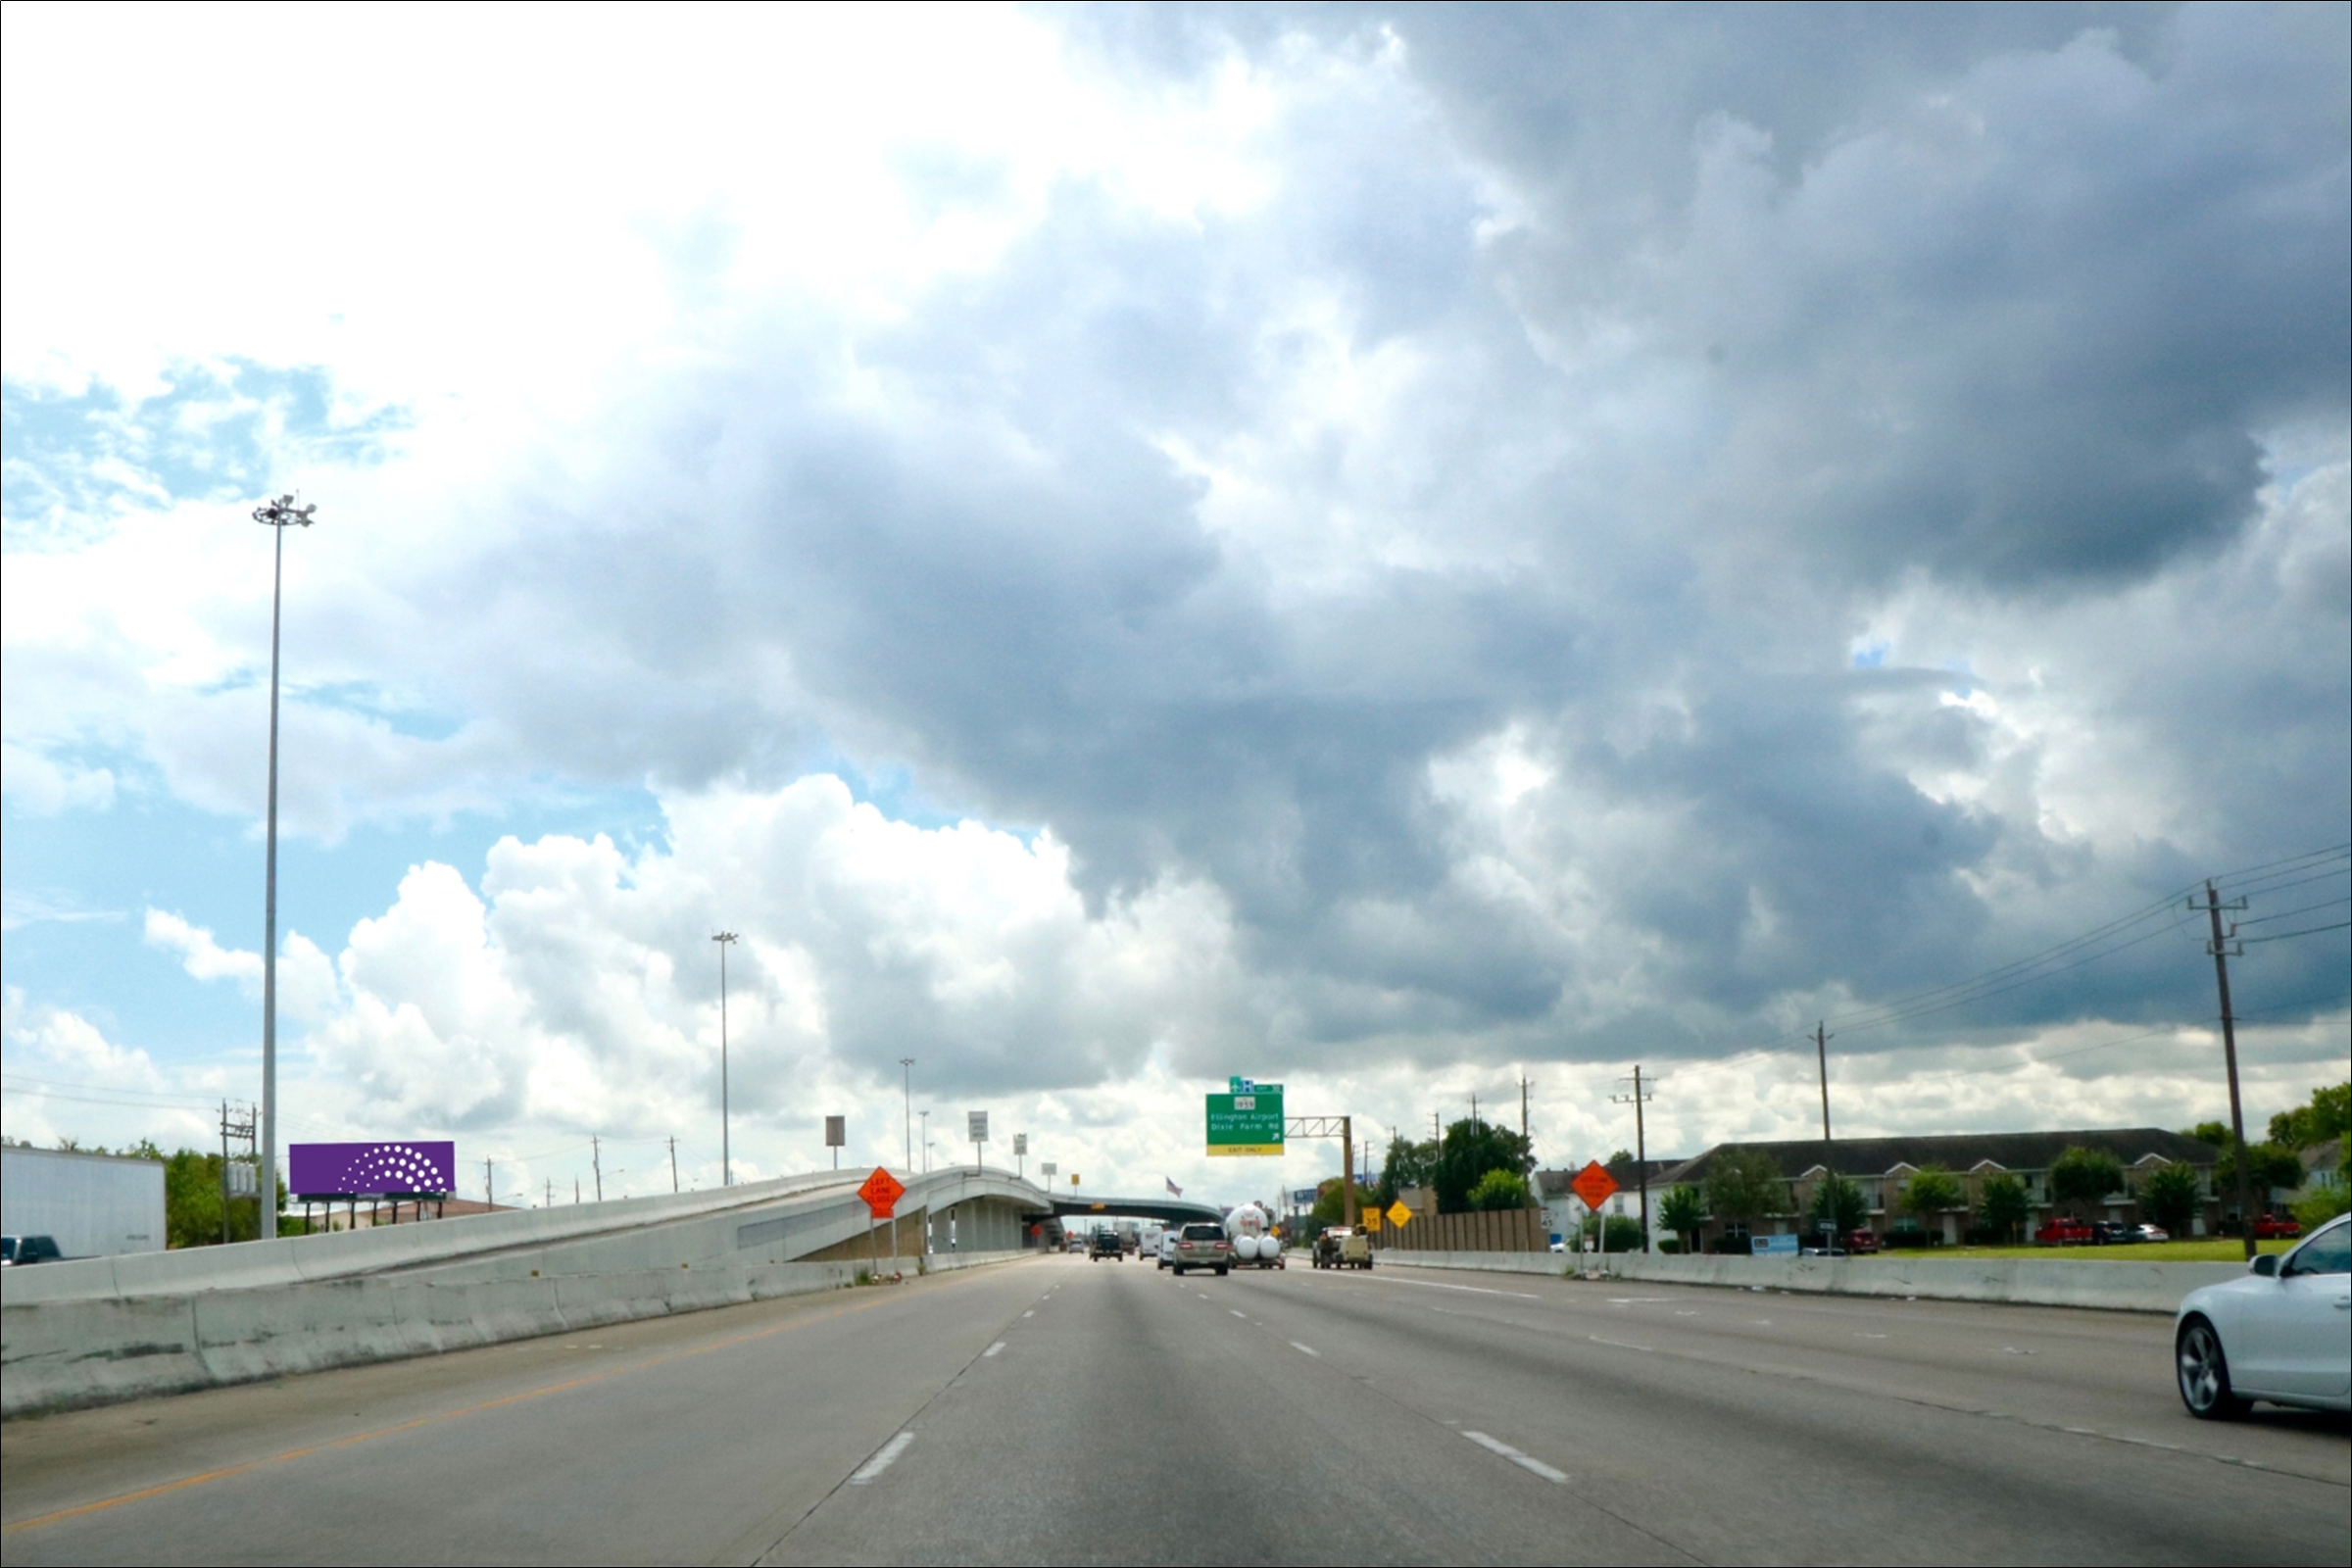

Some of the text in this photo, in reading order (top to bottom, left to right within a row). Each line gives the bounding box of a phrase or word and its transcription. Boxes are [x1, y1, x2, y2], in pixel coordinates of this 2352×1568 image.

[1236, 1101, 1254, 1109] 1959
[1210, 1112, 1279, 1122] Ellington Airport
[1240, 1122, 1263, 1131] Farm
[870, 1177, 891, 1186] LEFT
[870, 1186, 891, 1195] LANE
[866, 1195, 896, 1203] CLOSED
